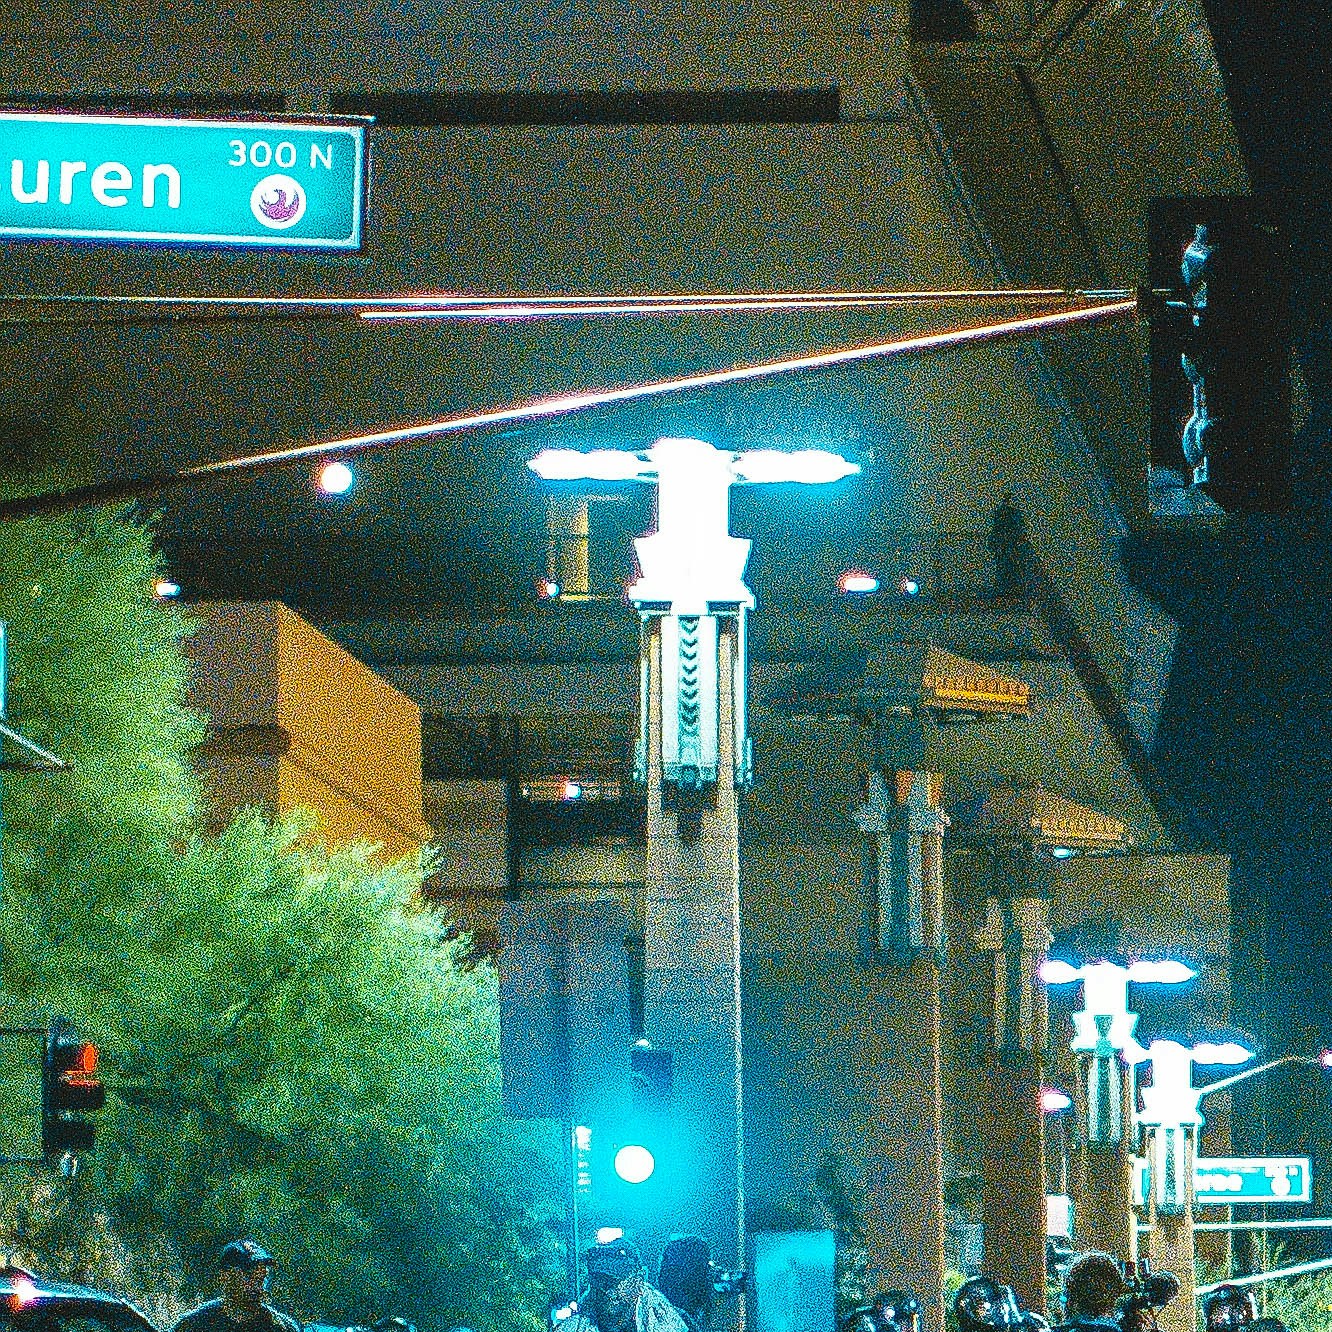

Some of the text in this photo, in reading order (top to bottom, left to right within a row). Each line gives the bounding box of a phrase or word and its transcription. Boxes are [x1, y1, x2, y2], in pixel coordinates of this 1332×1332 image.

[228, 139, 333, 170] 300 N
[0, 158, 181, 209] uren
